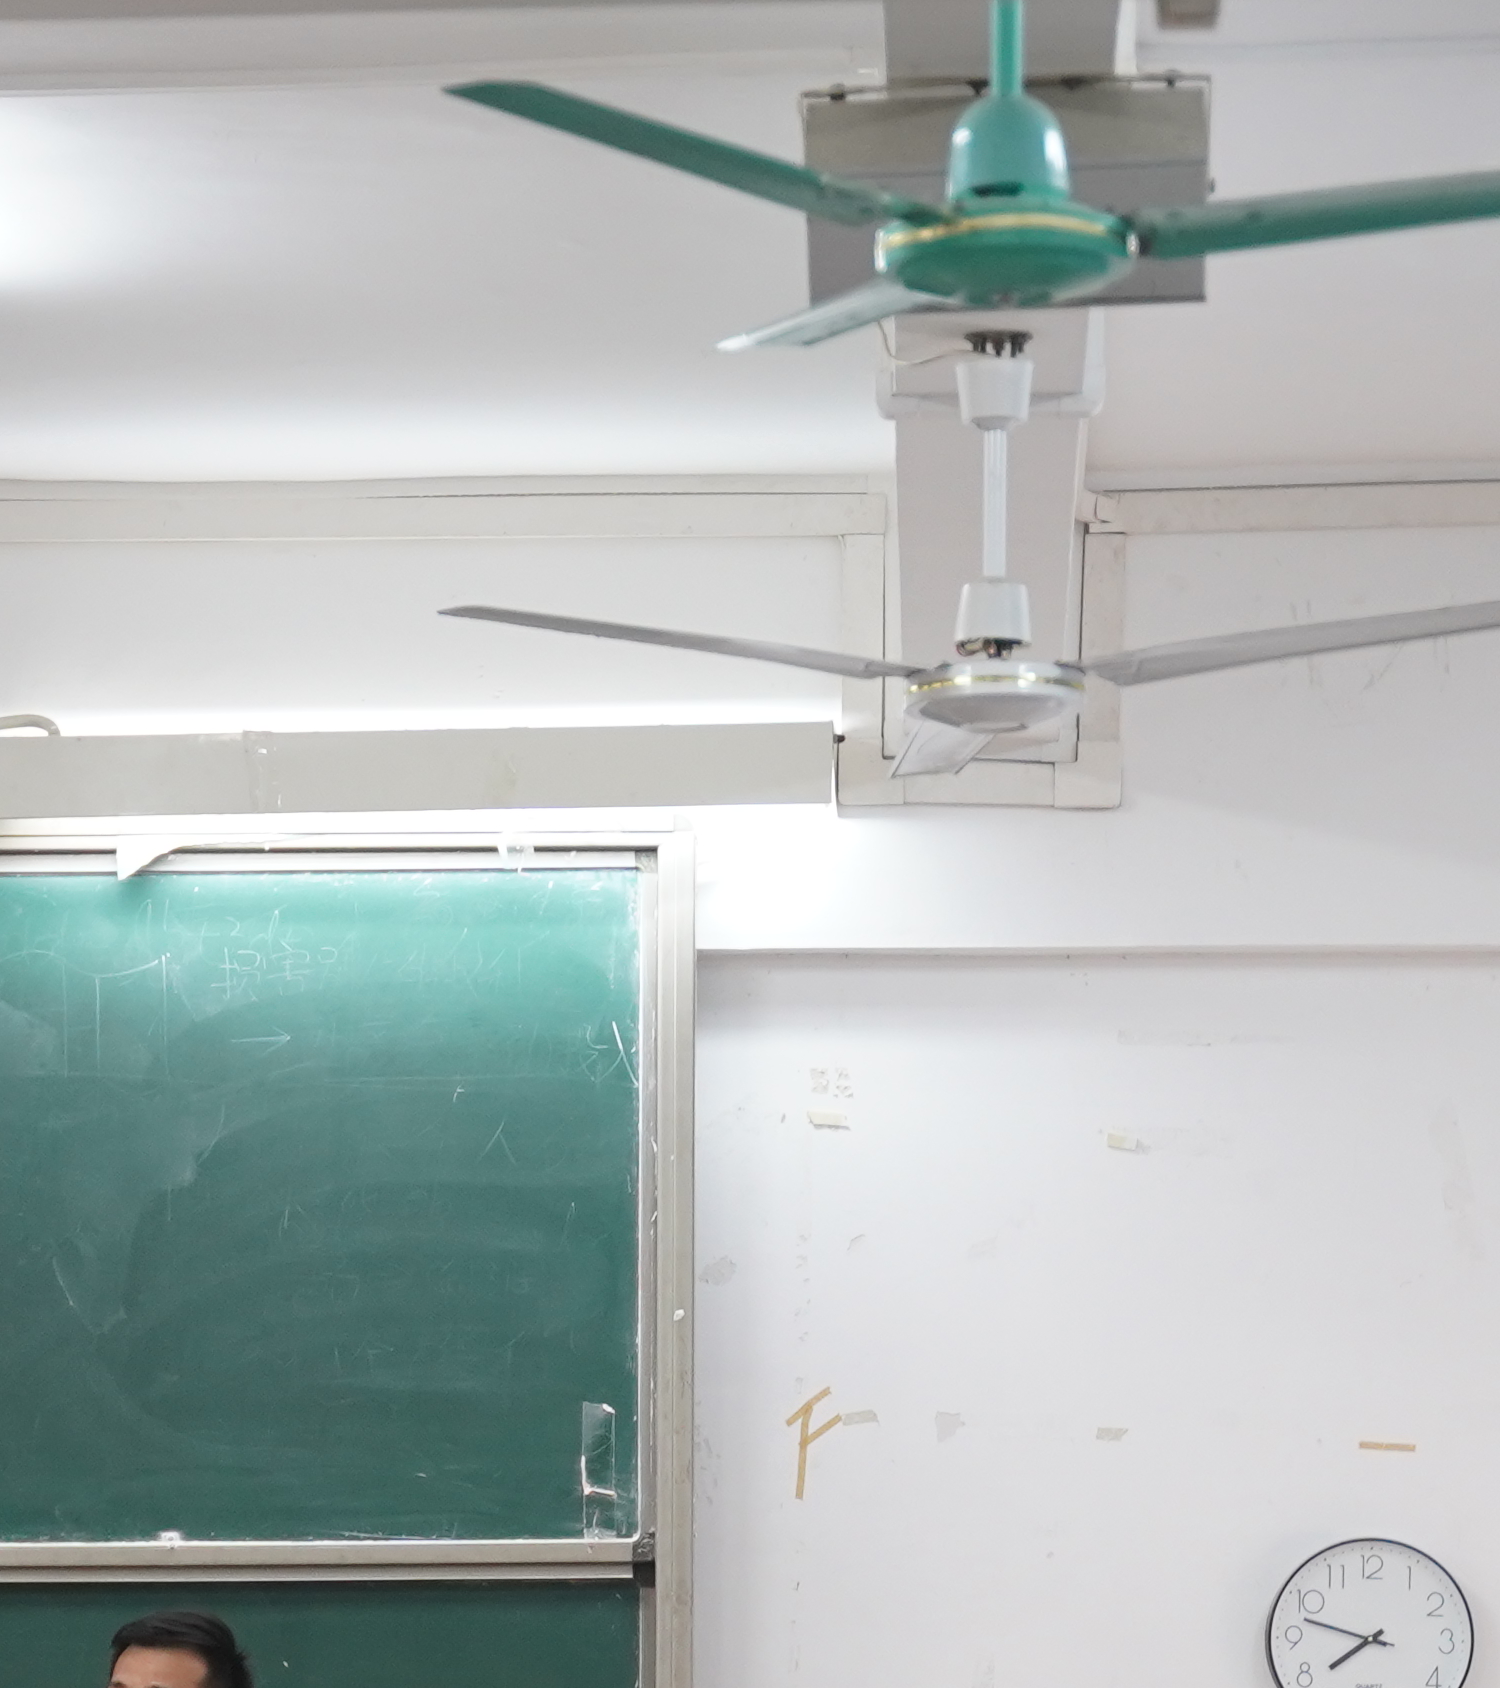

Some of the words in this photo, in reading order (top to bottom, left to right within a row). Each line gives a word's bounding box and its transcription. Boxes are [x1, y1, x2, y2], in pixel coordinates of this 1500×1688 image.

[1326, 1564, 1345, 1589] 11
[1360, 1554, 1384, 1580] 12
[1297, 1589, 1325, 1614] 10
[1426, 1592, 1445, 1617] 2
[1284, 1625, 1303, 1651] 9
[1438, 1628, 1455, 1654] 3
[1296, 1662, 1313, 1688] 8
